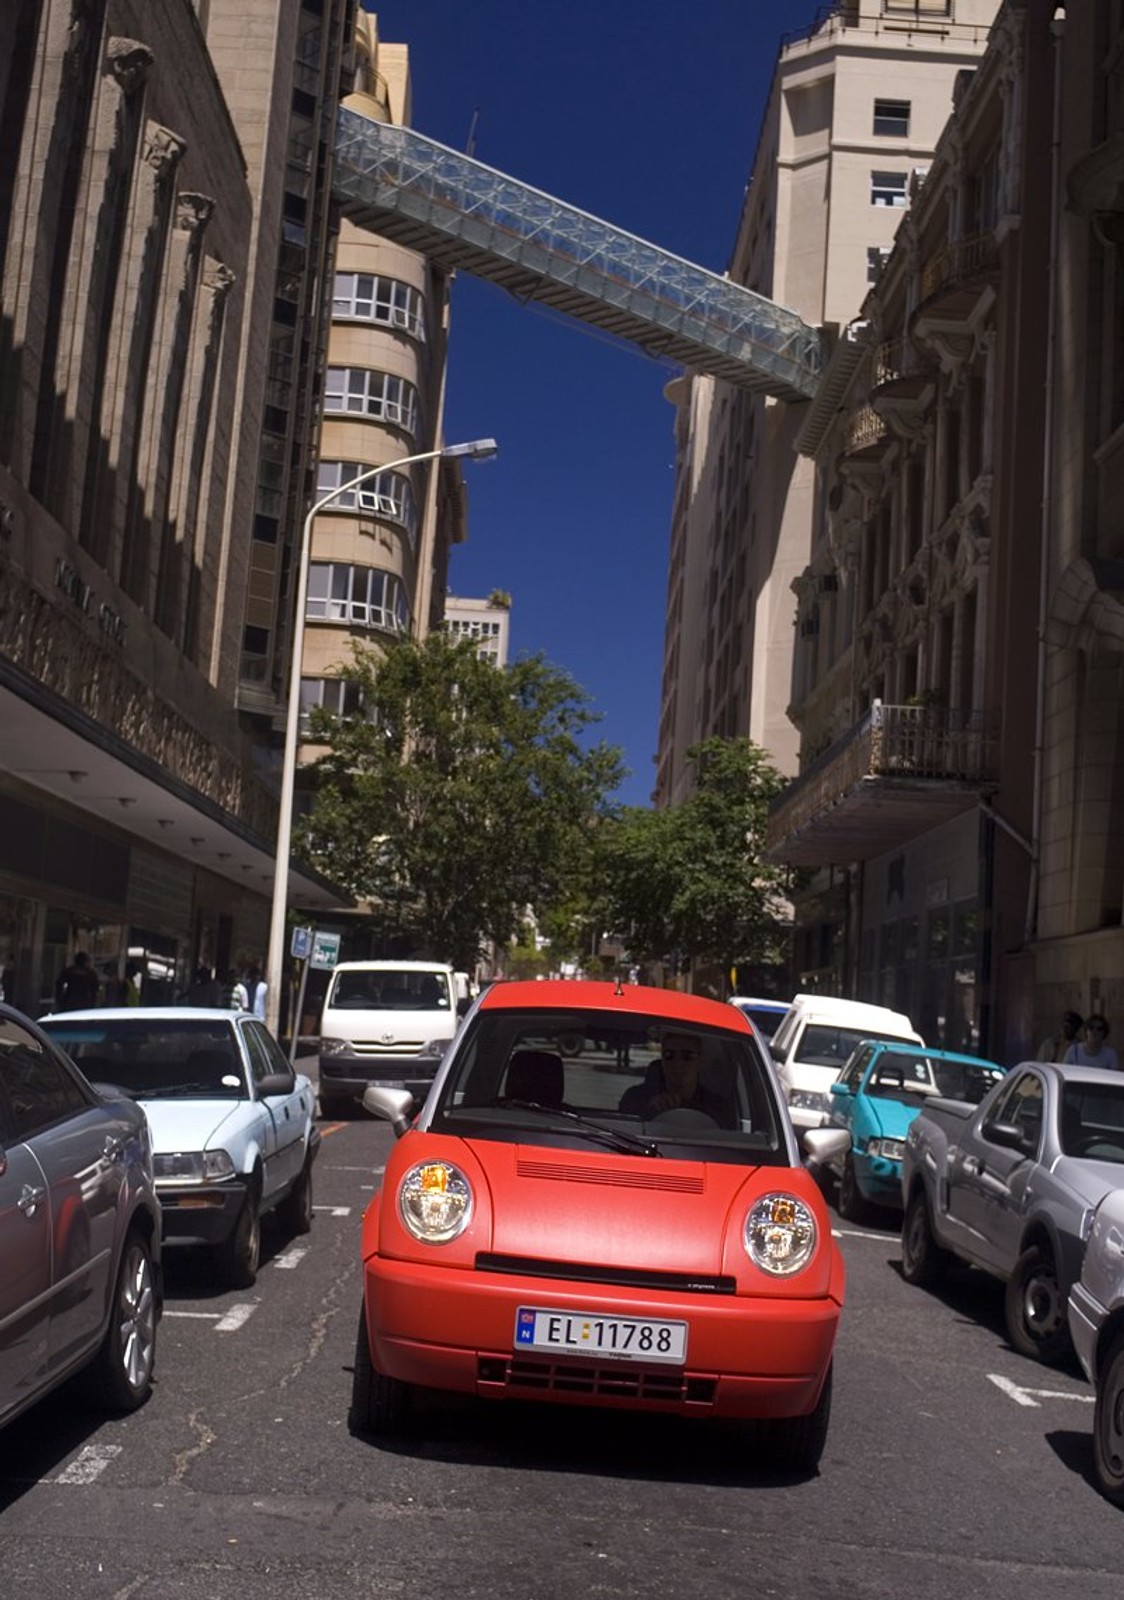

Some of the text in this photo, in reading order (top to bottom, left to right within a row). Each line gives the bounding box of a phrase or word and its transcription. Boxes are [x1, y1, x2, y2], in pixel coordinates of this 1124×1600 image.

[521, 1330, 530, 1339] N
[547, 1317, 671, 1352] EL 11788
